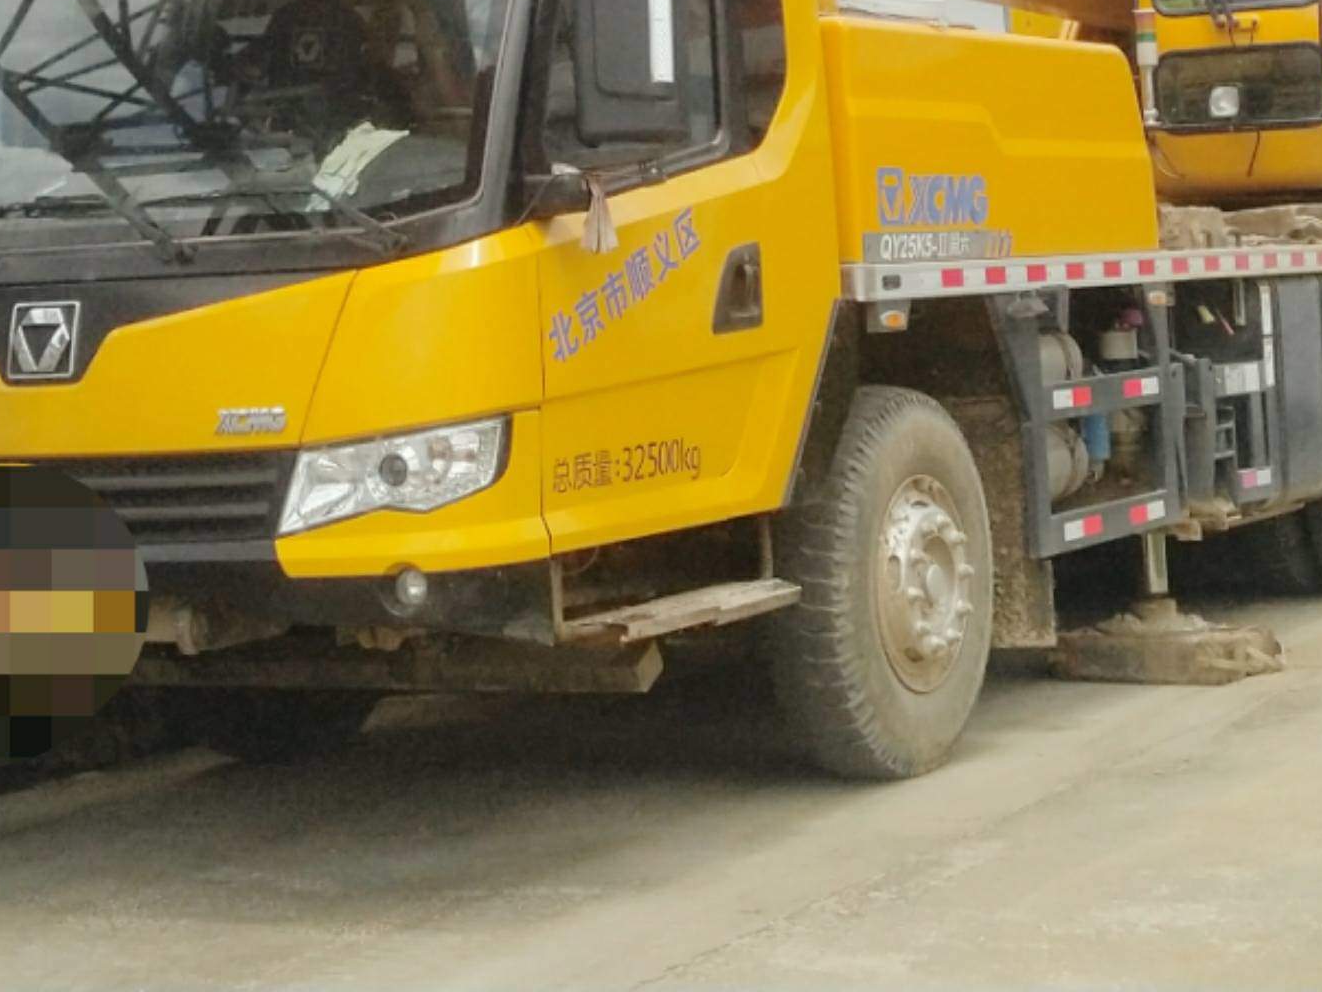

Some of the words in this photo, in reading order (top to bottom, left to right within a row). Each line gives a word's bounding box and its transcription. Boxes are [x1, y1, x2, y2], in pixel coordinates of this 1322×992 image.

[908, 175, 989, 225] XCMG
[549, 207, 701, 363] 北京市顺义区
[216, 406, 286, 435] XCMG
